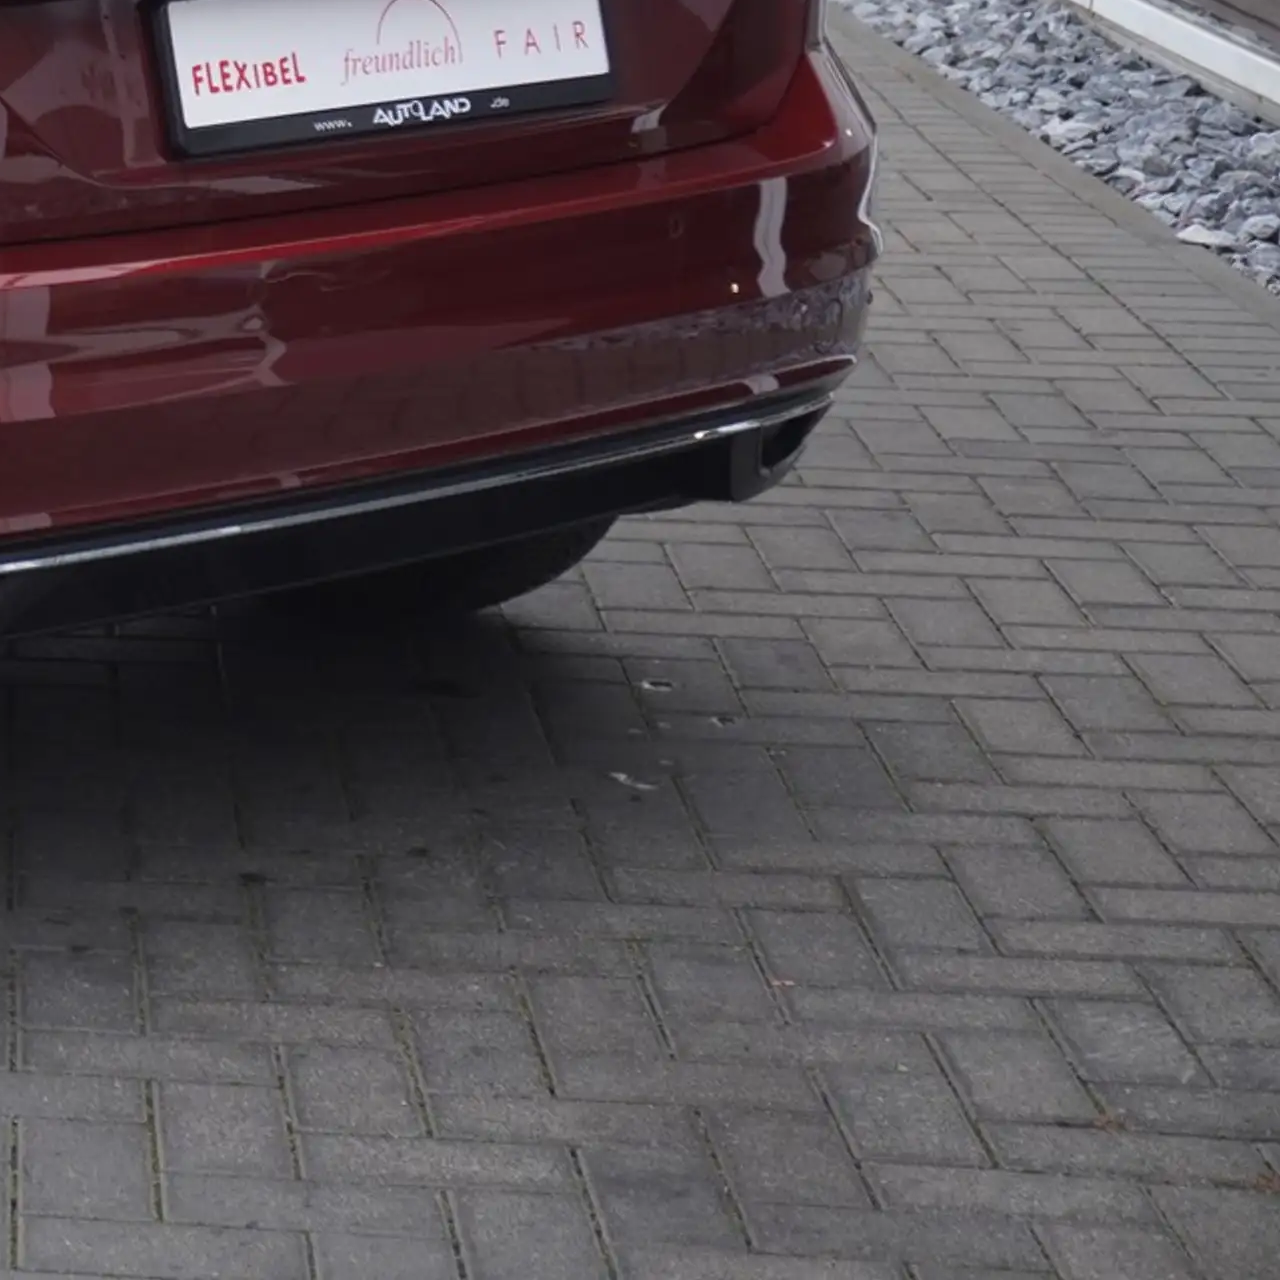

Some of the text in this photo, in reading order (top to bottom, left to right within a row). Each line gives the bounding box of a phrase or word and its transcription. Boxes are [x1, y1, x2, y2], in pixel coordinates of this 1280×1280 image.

[191, 52, 306, 96] FLEXIBEL
[340, 36, 456, 87] freundlich
[313, 119, 353, 131] www.
[373, 97, 471, 126] AUTOLAND
